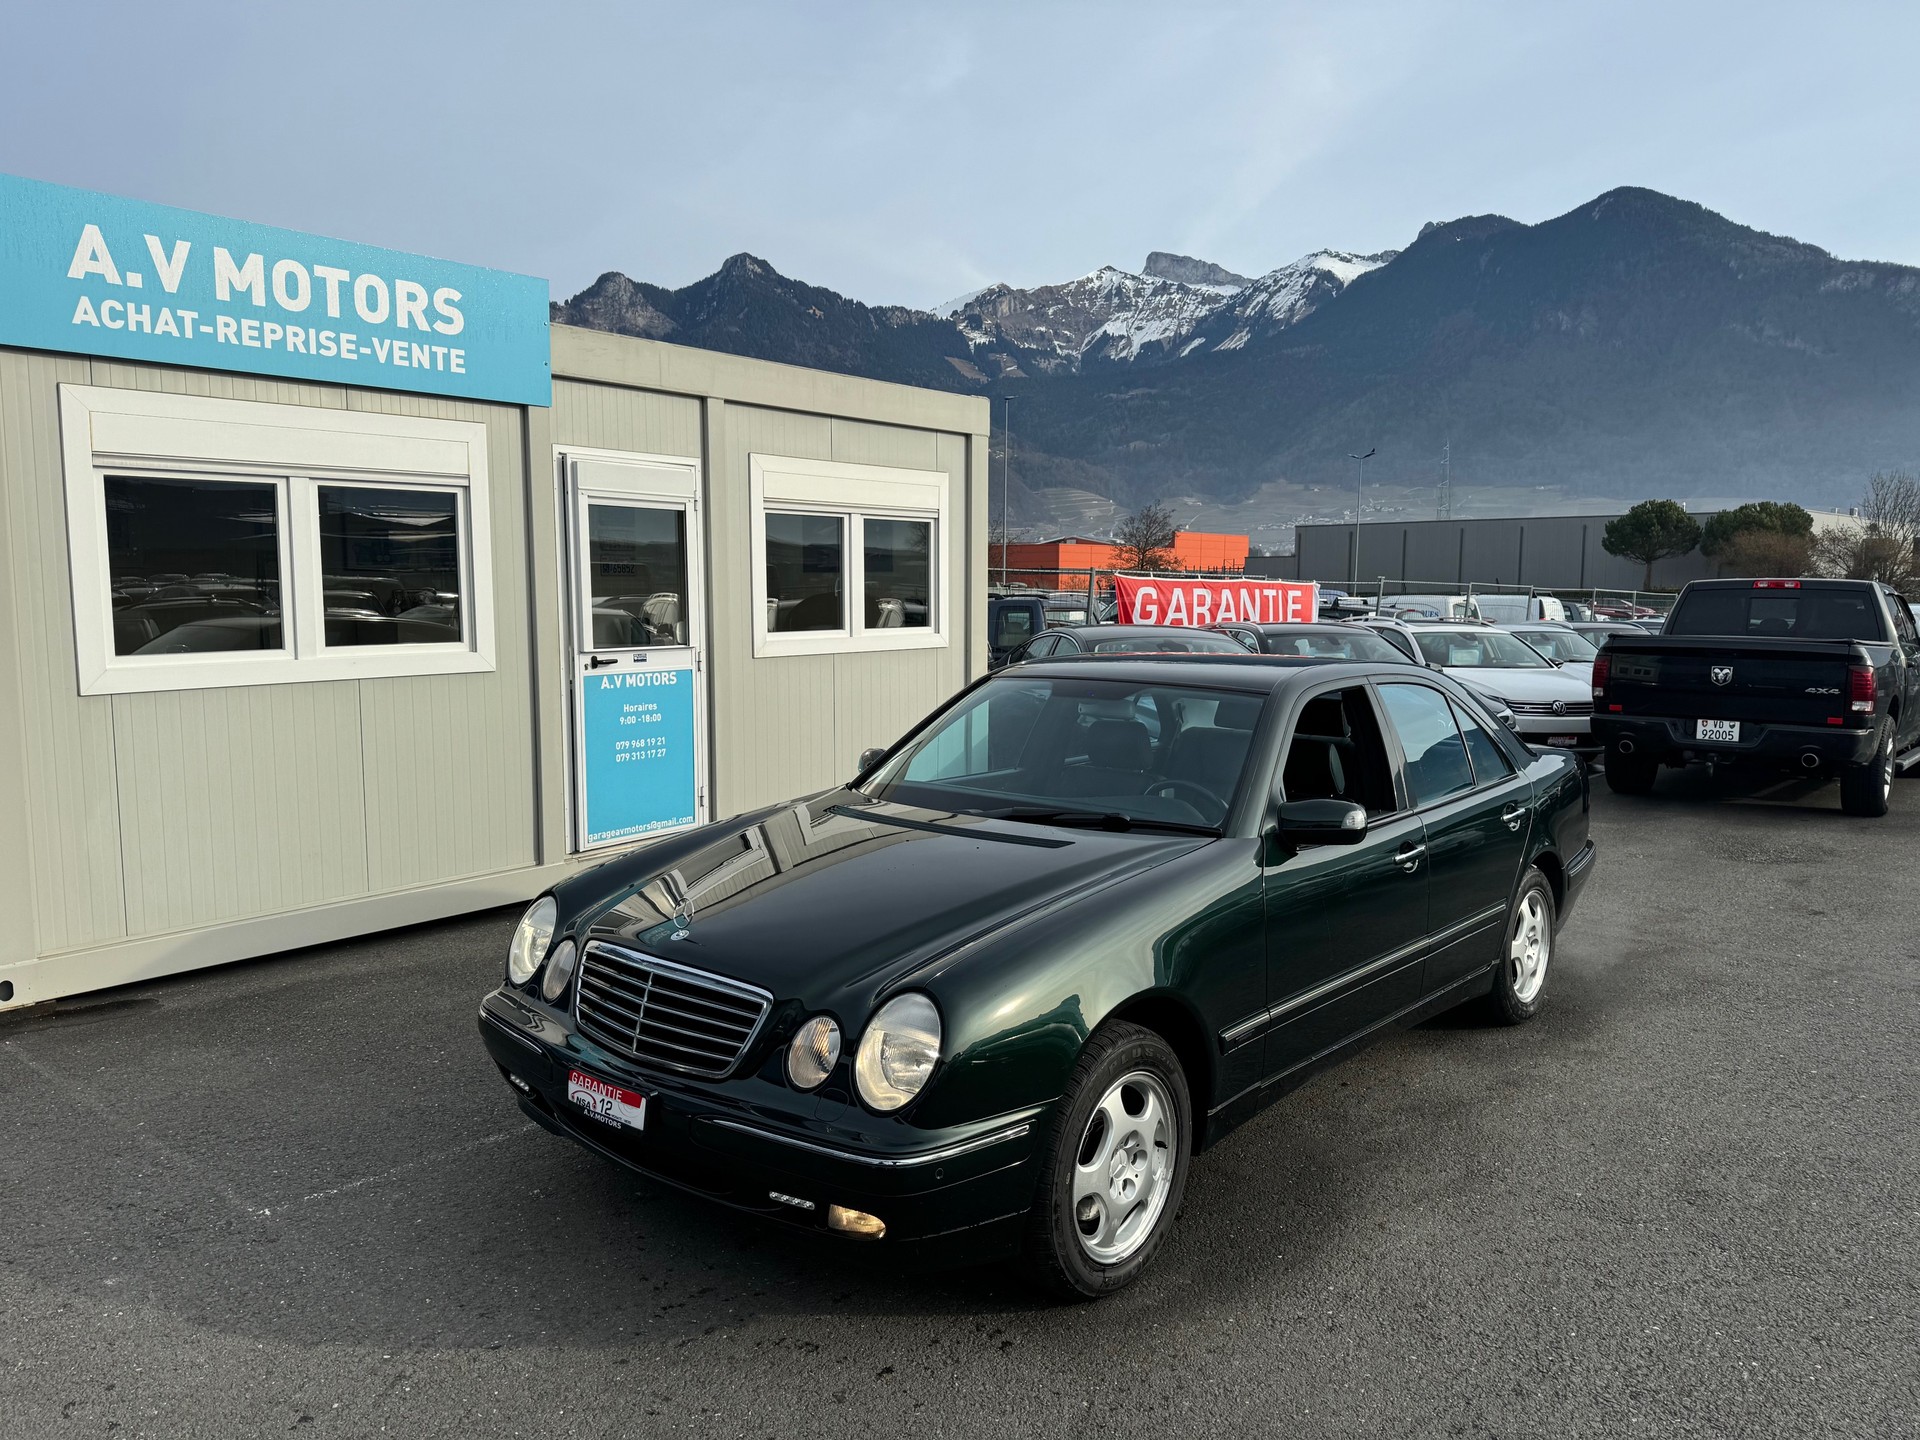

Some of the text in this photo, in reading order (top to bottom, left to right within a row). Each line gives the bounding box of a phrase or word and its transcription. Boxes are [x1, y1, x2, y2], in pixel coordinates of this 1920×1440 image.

[67, 223, 465, 336] A.V MOTORS
[71, 295, 466, 374] ACHAT-REPRISE-VENTE
[1132, 586, 1303, 626] GARANTIE
[600, 671, 677, 690] A.V MOTORS
[623, 702, 658, 713] Horaires
[619, 715, 637, 725] 9:00
[1713, 720, 1724, 729] VD
[1701, 729, 1734, 740] 92005
[615, 736, 666, 751] 079 968 19 21
[615, 748, 667, 763] 079 313 17 27
[588, 815, 694, 842] garageavmotors@gmail.com
[571, 1072, 622, 1102] GARANTIE
[575, 1096, 591, 1110] NSA
[599, 1098, 613, 1117] 12
